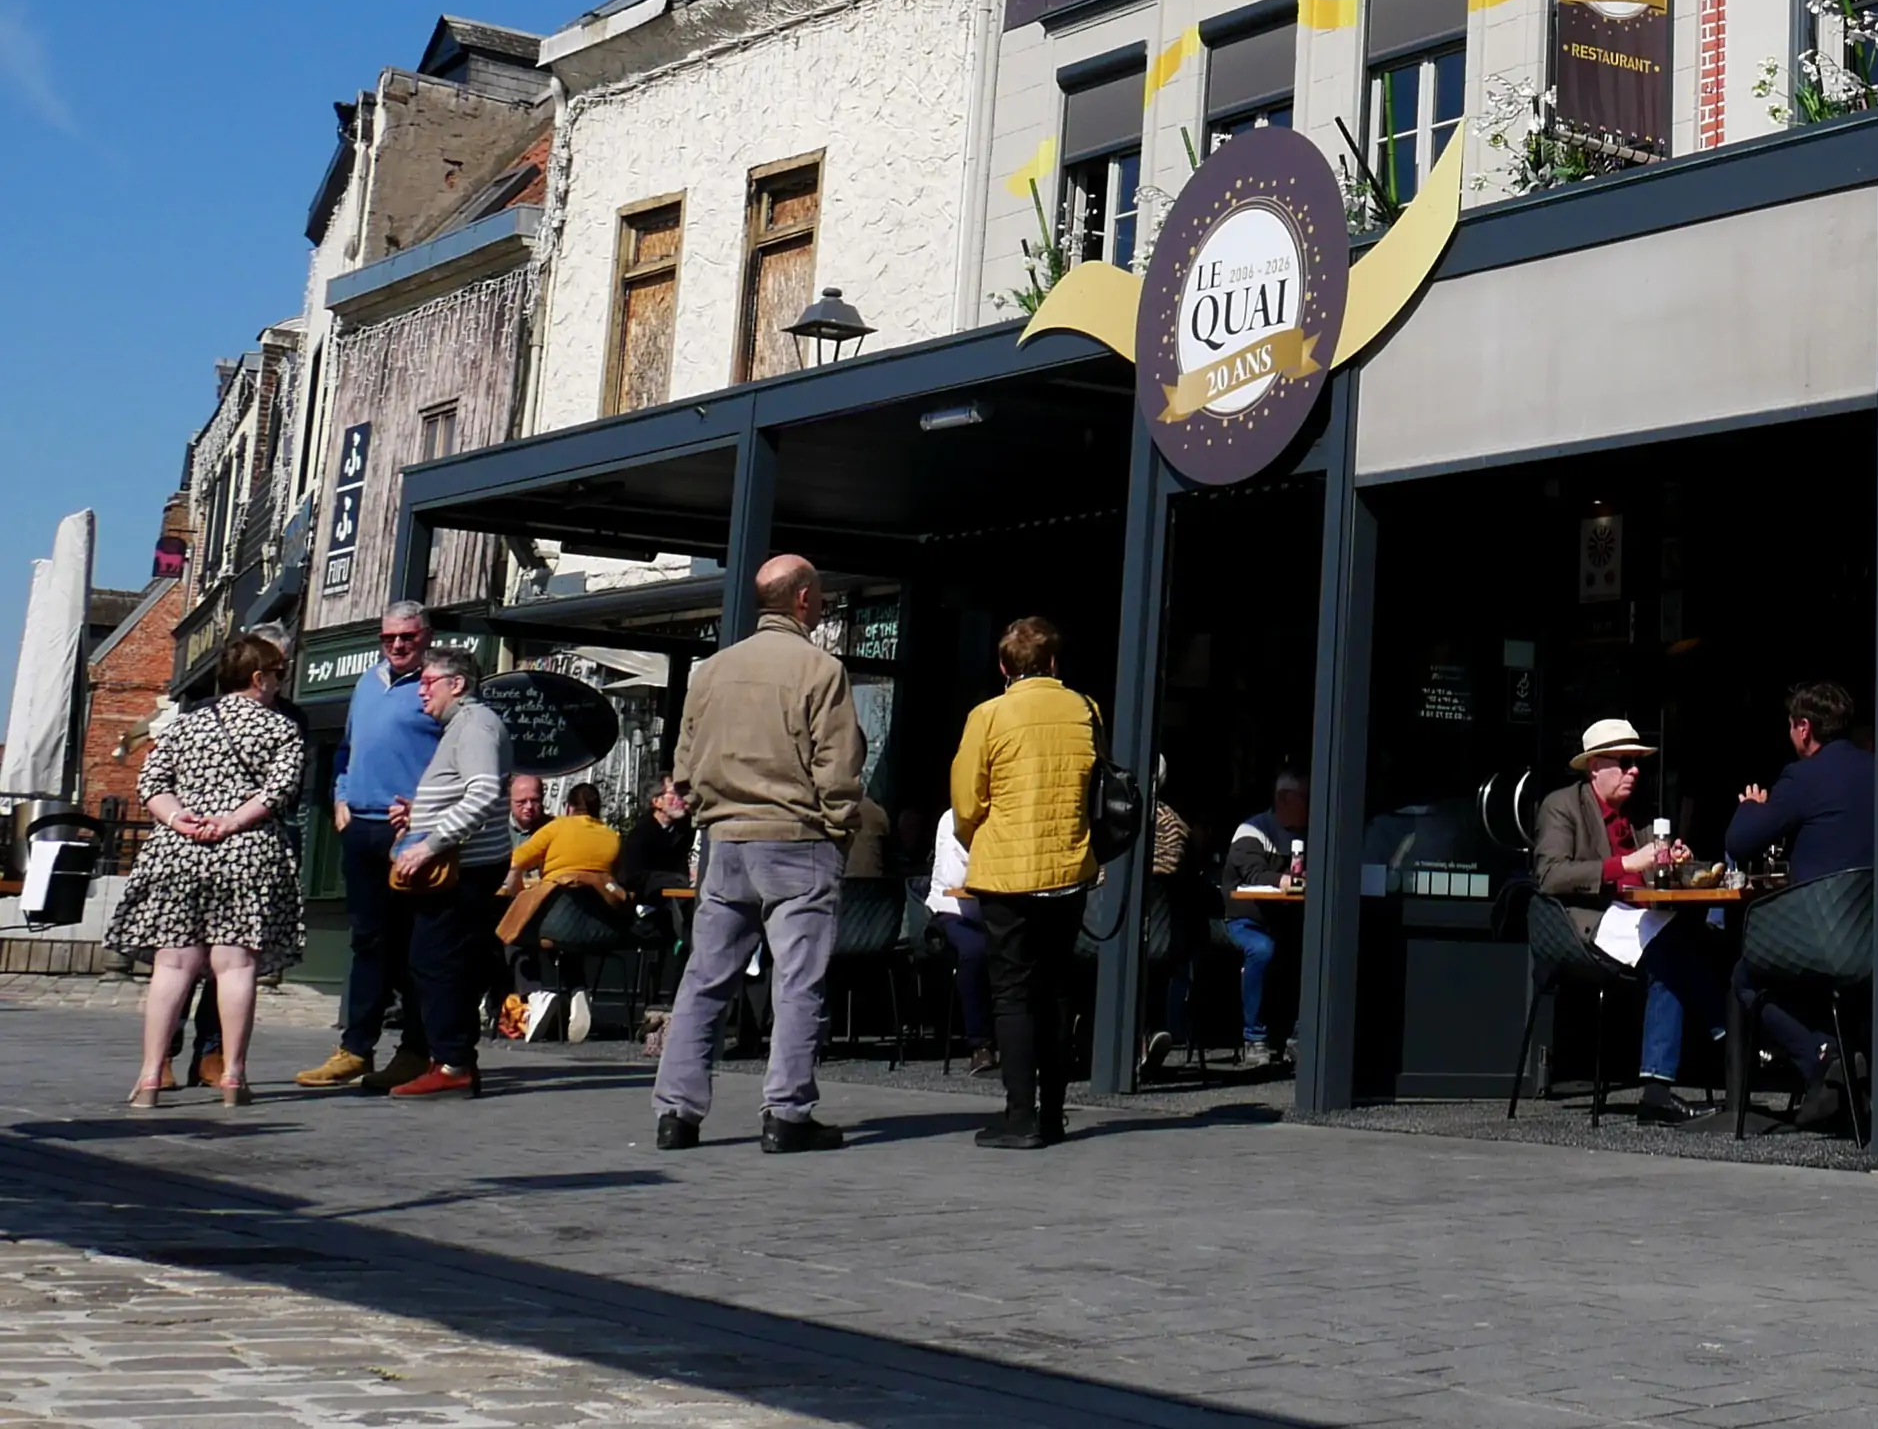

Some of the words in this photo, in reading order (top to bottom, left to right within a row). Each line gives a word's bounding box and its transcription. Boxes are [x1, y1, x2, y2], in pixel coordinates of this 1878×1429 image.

[1571, 42, 1652, 74] RESTAURANT
[1197, 260, 1223, 291] LE
[1229, 263, 1254, 284] 2006
[1265, 256, 1291, 275] 2026
[1191, 278, 1290, 351] QUAI
[1206, 365, 1228, 397] 20
[1231, 344, 1272, 385] ANS
[326, 556, 351, 585] FUFU
[865, 623, 879, 640] OF
[880, 622, 898, 638] THE
[856, 637, 899, 660] HEART
